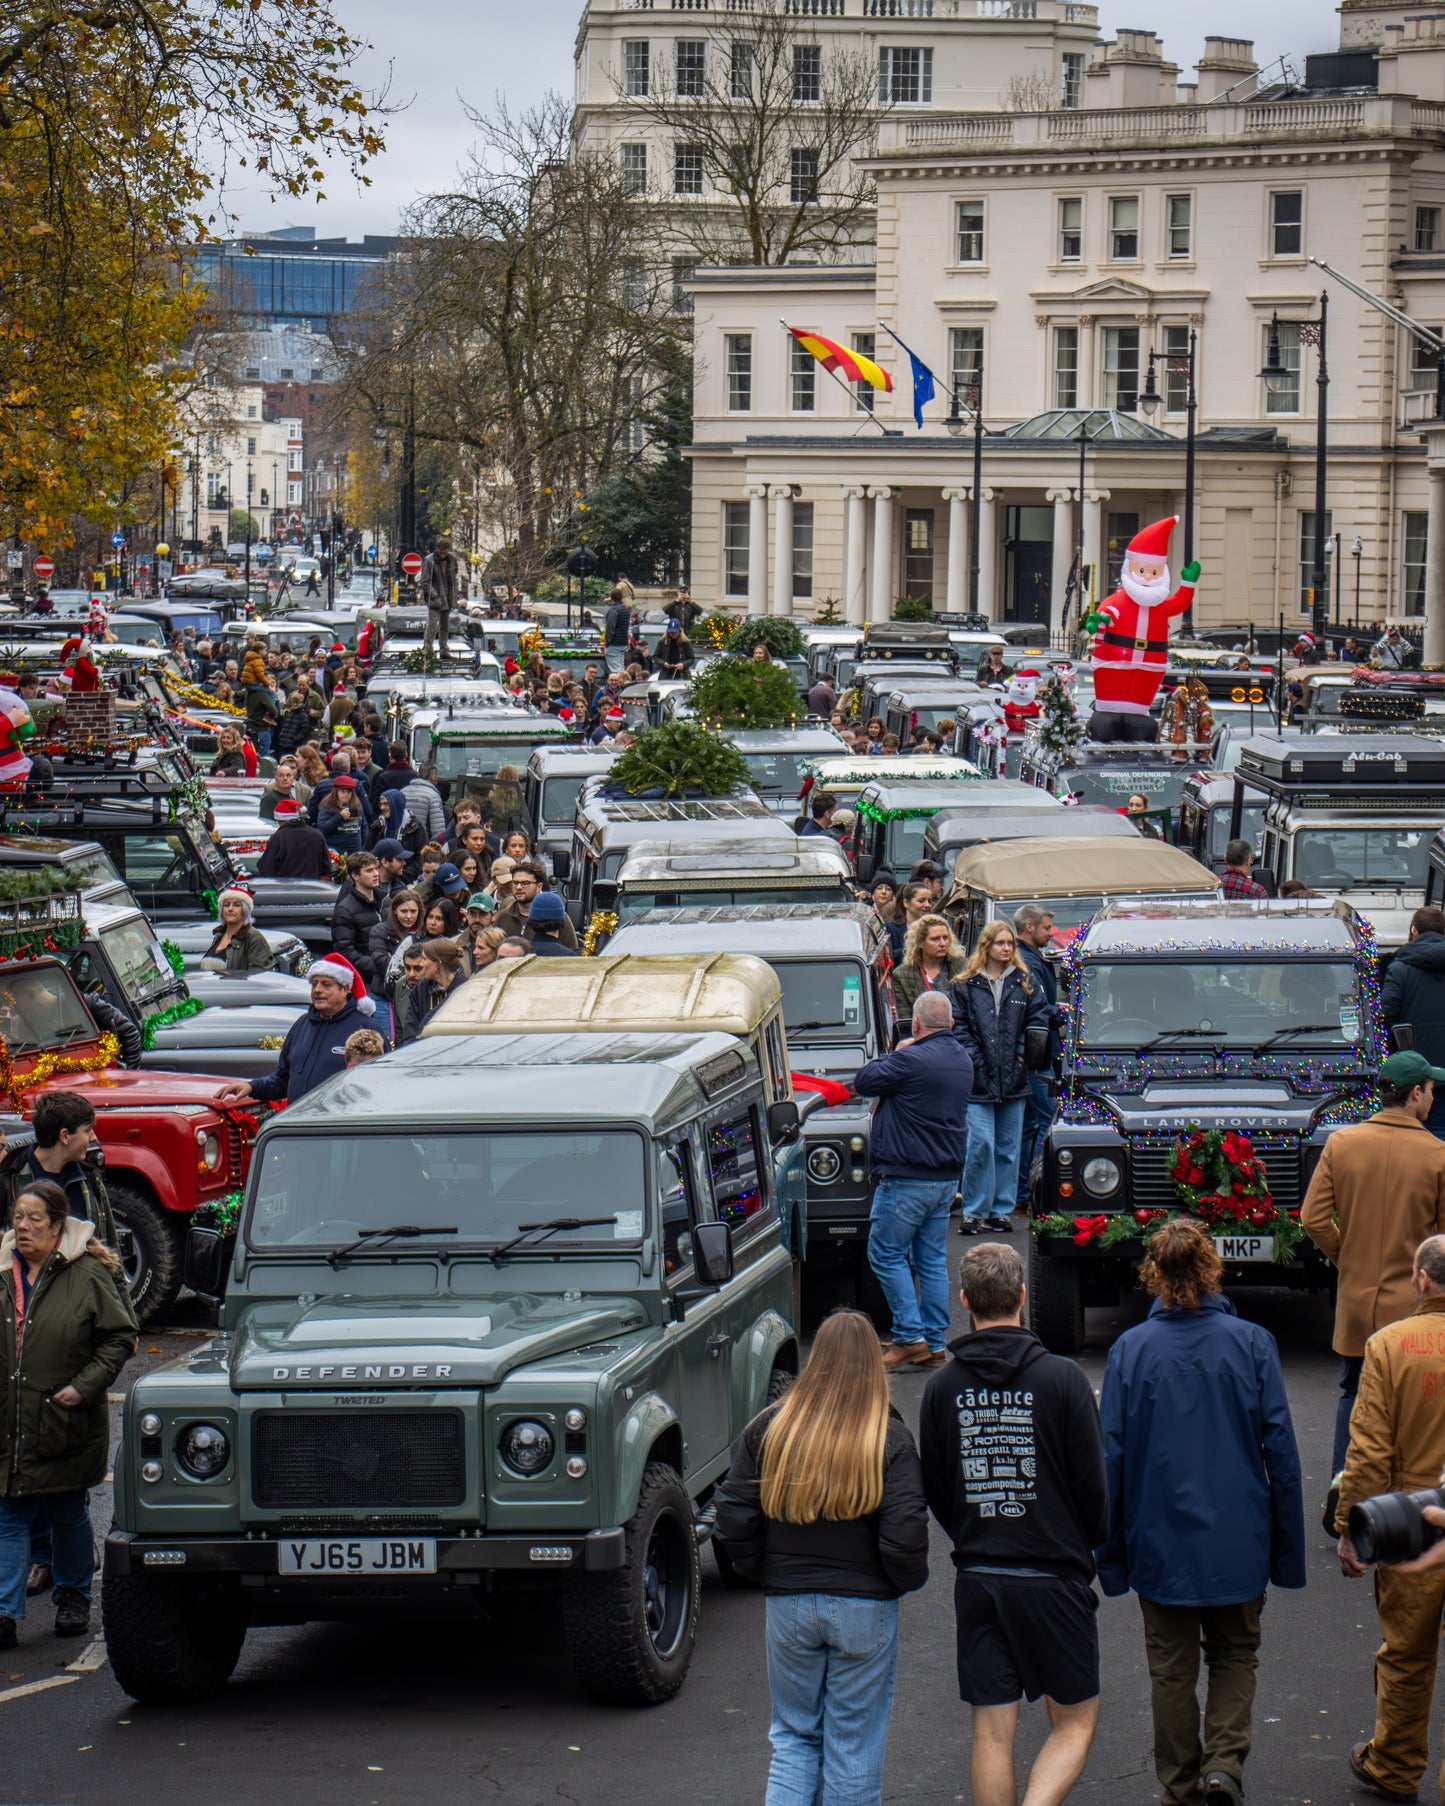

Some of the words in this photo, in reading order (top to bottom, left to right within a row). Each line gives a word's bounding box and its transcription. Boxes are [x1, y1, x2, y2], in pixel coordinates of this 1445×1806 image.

[1347, 752, 1402, 761] Alu-Cab
[1143, 1118, 1202, 1127] LAND
[1215, 1118, 1289, 1127] ROVER
[1222, 1239, 1262, 1257] MKP
[1401, 1332, 1434, 1355] WALLS
[272, 1365, 452, 1380] DEFENDER
[333, 1396, 386, 1405] TWISTED
[956, 1388, 1033, 1408] cādence
[974, 1436, 1034, 1446] ROTOBOX
[988, 1446, 1011, 1455] GRILL
[964, 1459, 987, 1478] RS
[965, 1479, 1026, 1492] easycomposites
[291, 1543, 363, 1570] YJ65
[372, 1542, 425, 1569] JBM
